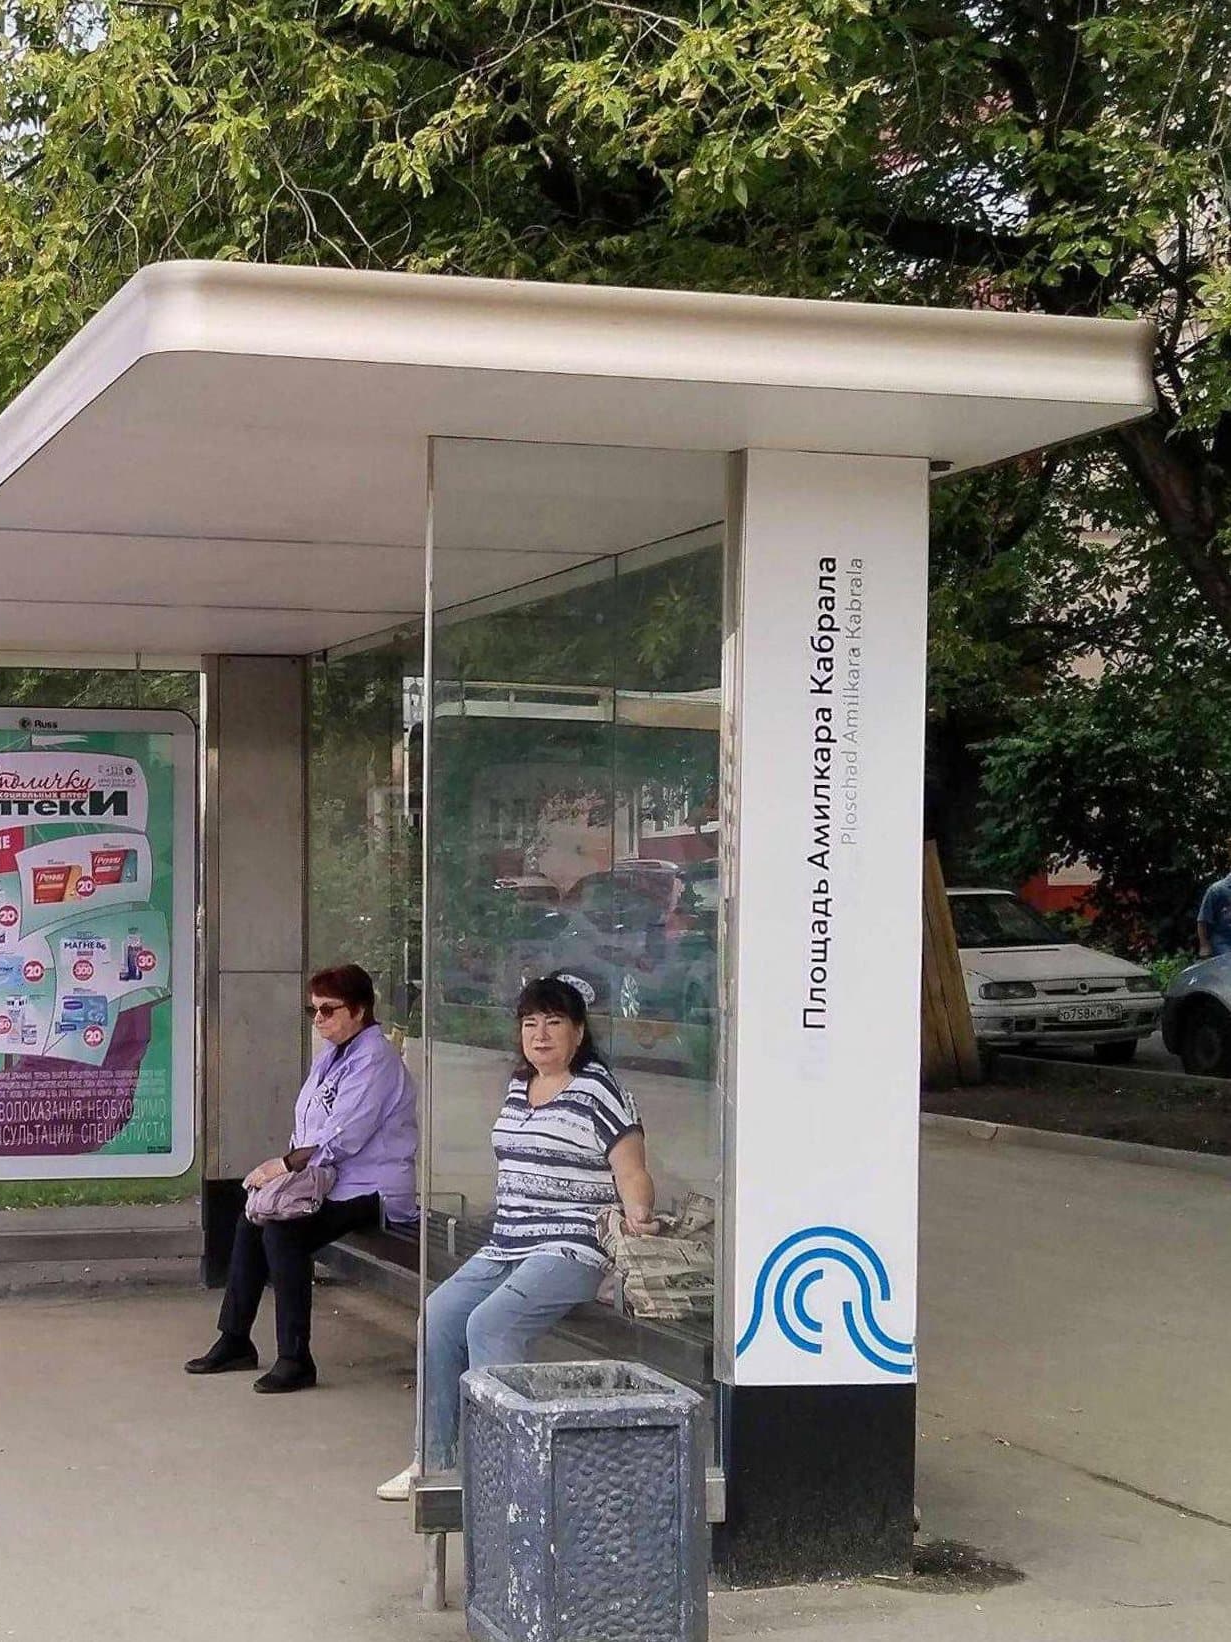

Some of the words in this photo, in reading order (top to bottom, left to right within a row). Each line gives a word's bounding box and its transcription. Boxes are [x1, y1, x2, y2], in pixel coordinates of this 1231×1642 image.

[809, 555, 842, 696] Кабрала
[843, 556, 865, 641] Kabrala
[34, 719, 58, 729] Russ
[842, 648, 862, 744] Amilkara
[807, 706, 838, 872] Амилкара
[840, 751, 859, 846] Ploschad
[803, 878, 832, 1030] Площадь
